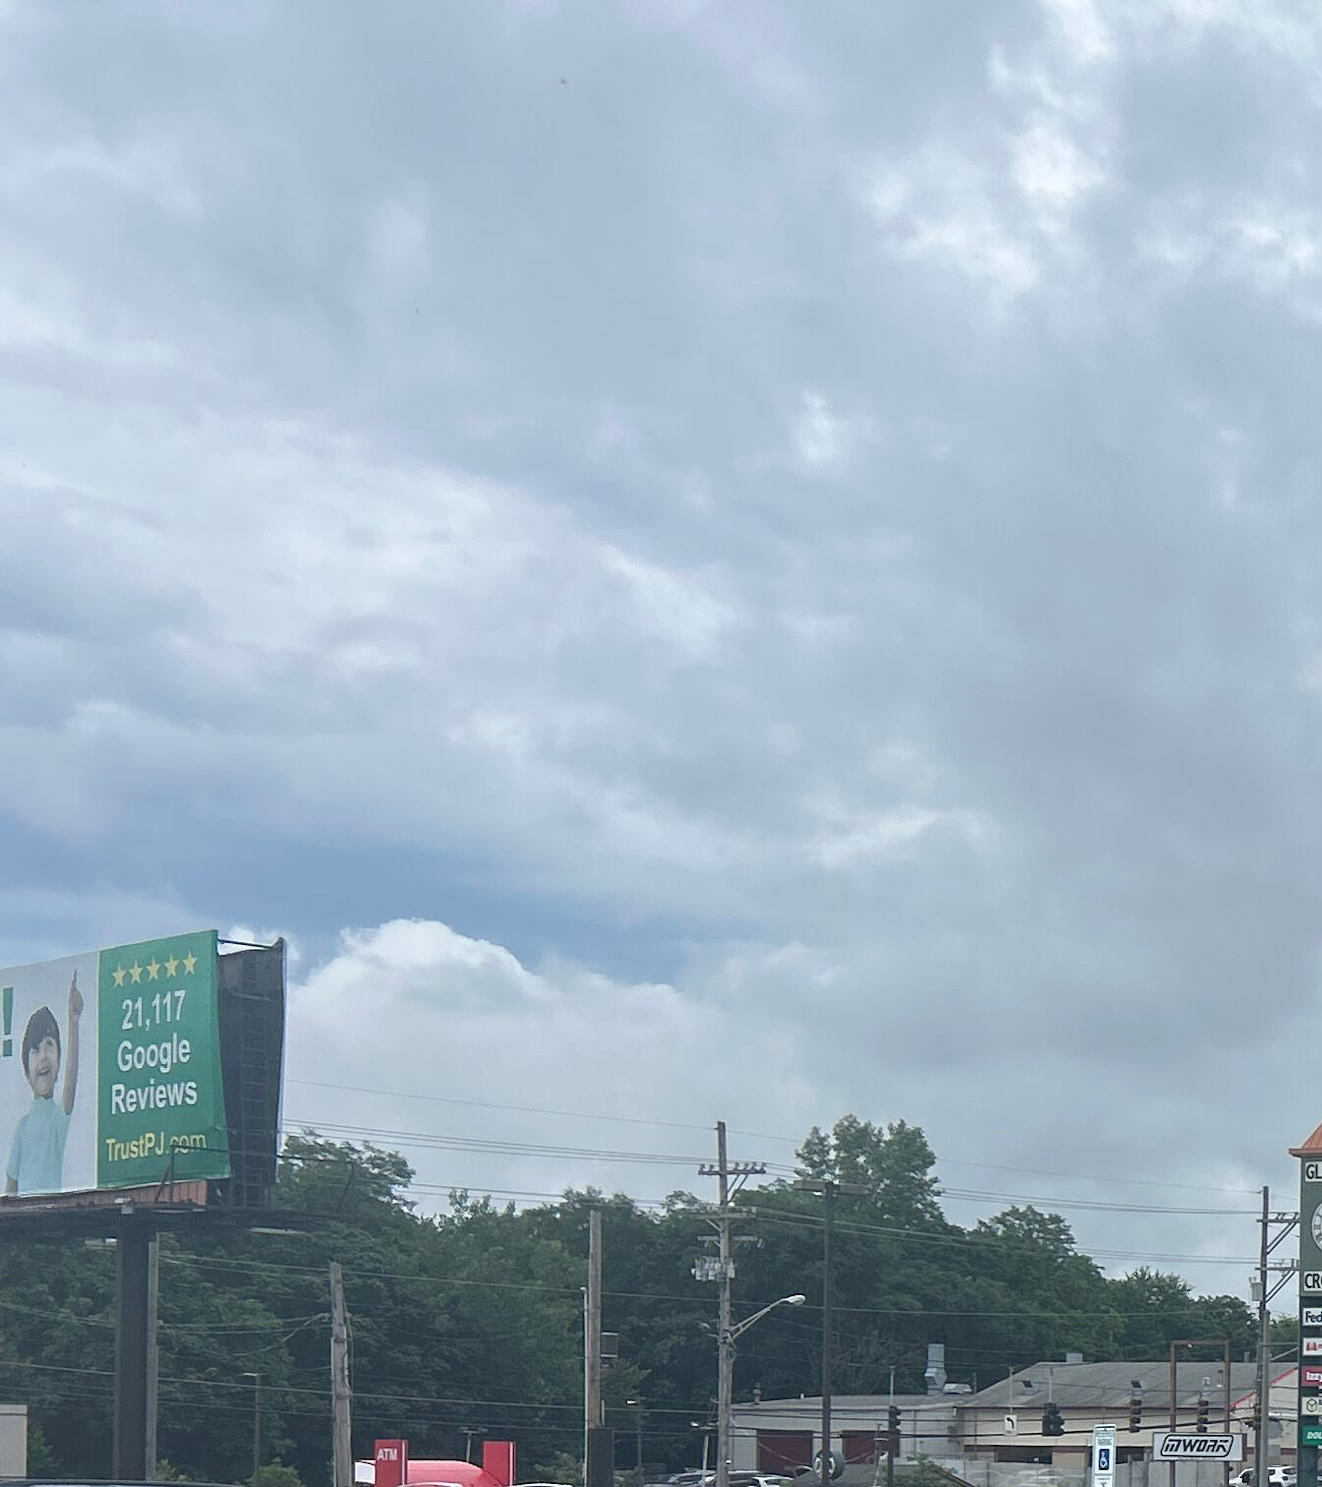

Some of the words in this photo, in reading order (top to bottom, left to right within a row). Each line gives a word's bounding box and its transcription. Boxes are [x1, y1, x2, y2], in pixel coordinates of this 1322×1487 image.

[122, 990, 186, 1031] 21,117
[118, 1032, 190, 1074] Google
[112, 1079, 198, 1114] Reviews
[106, 1131, 207, 1162] TrustPJ.com
[377, 1448, 398, 1461] ATM
